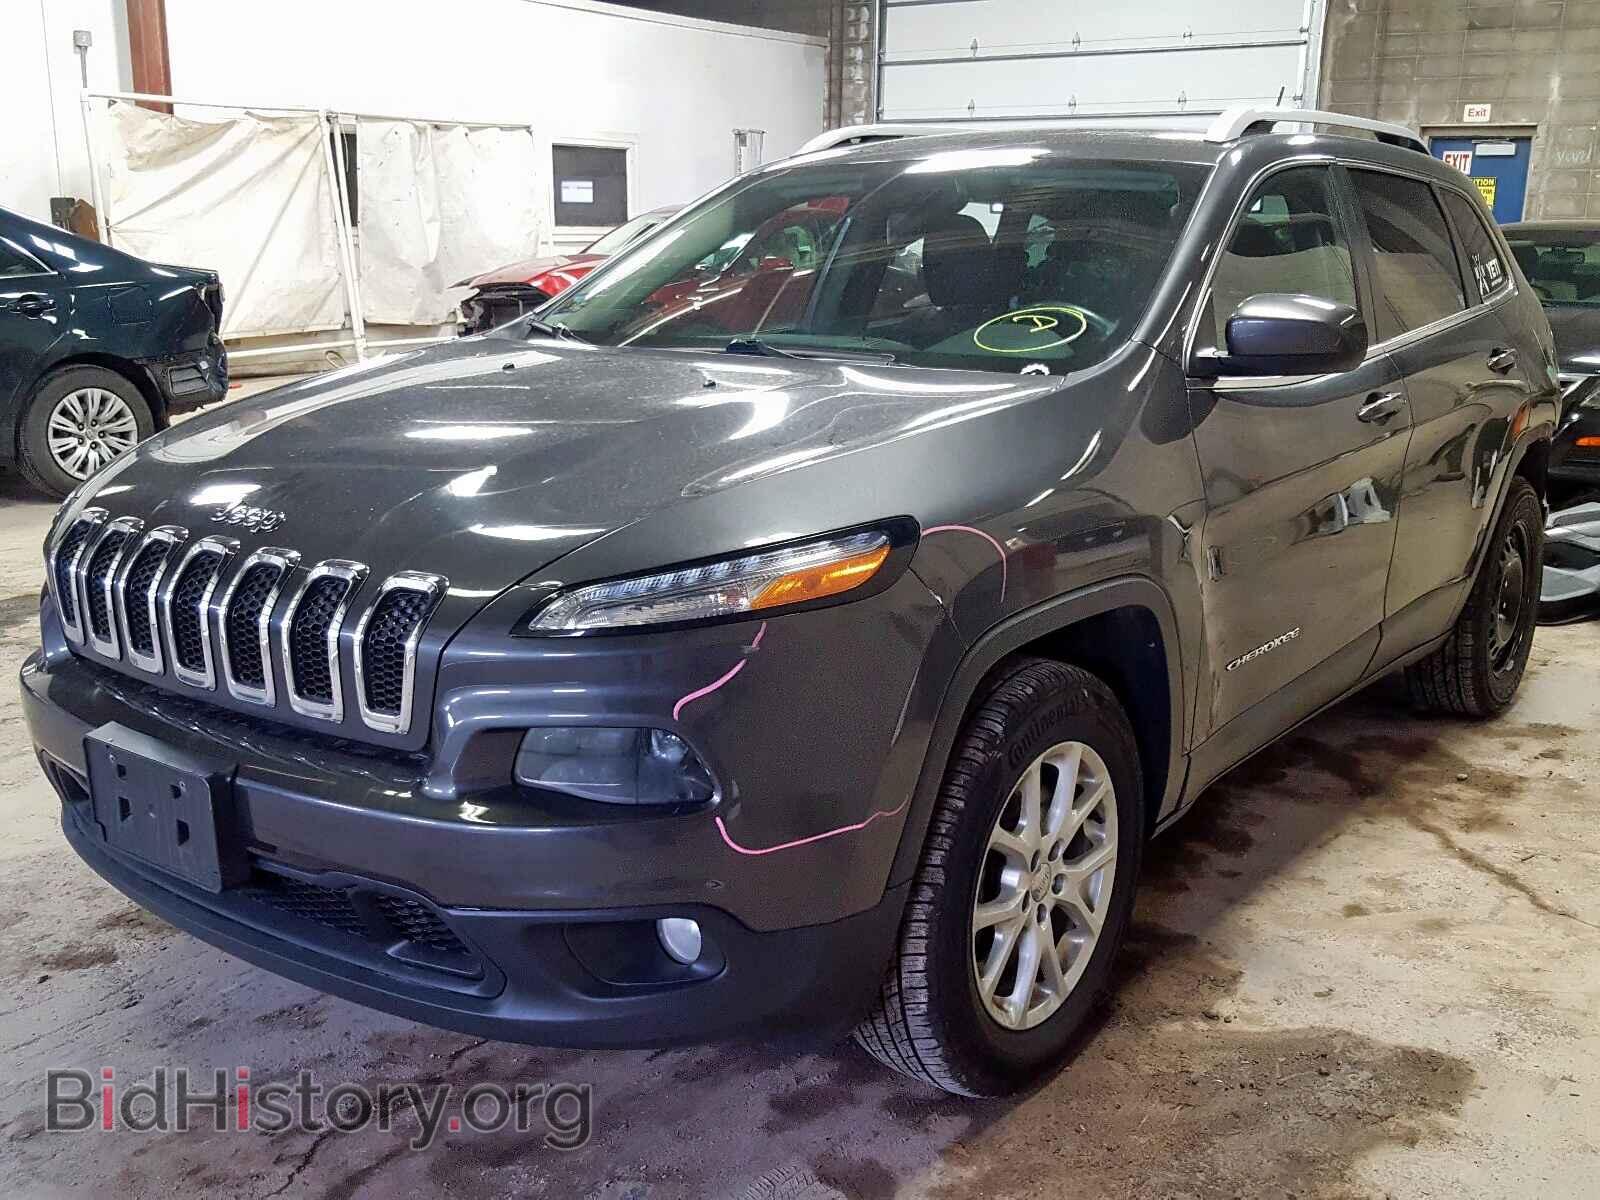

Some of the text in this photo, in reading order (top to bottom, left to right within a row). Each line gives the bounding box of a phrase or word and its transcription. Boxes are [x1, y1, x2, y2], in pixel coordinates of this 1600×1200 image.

[1467, 108, 1487, 117] Exit
[1445, 154, 1470, 171] EXIT
[1471, 178, 1495, 186] TION
[209, 505, 282, 533] Jeep
[1226, 627, 1300, 671] CHEROKEE
